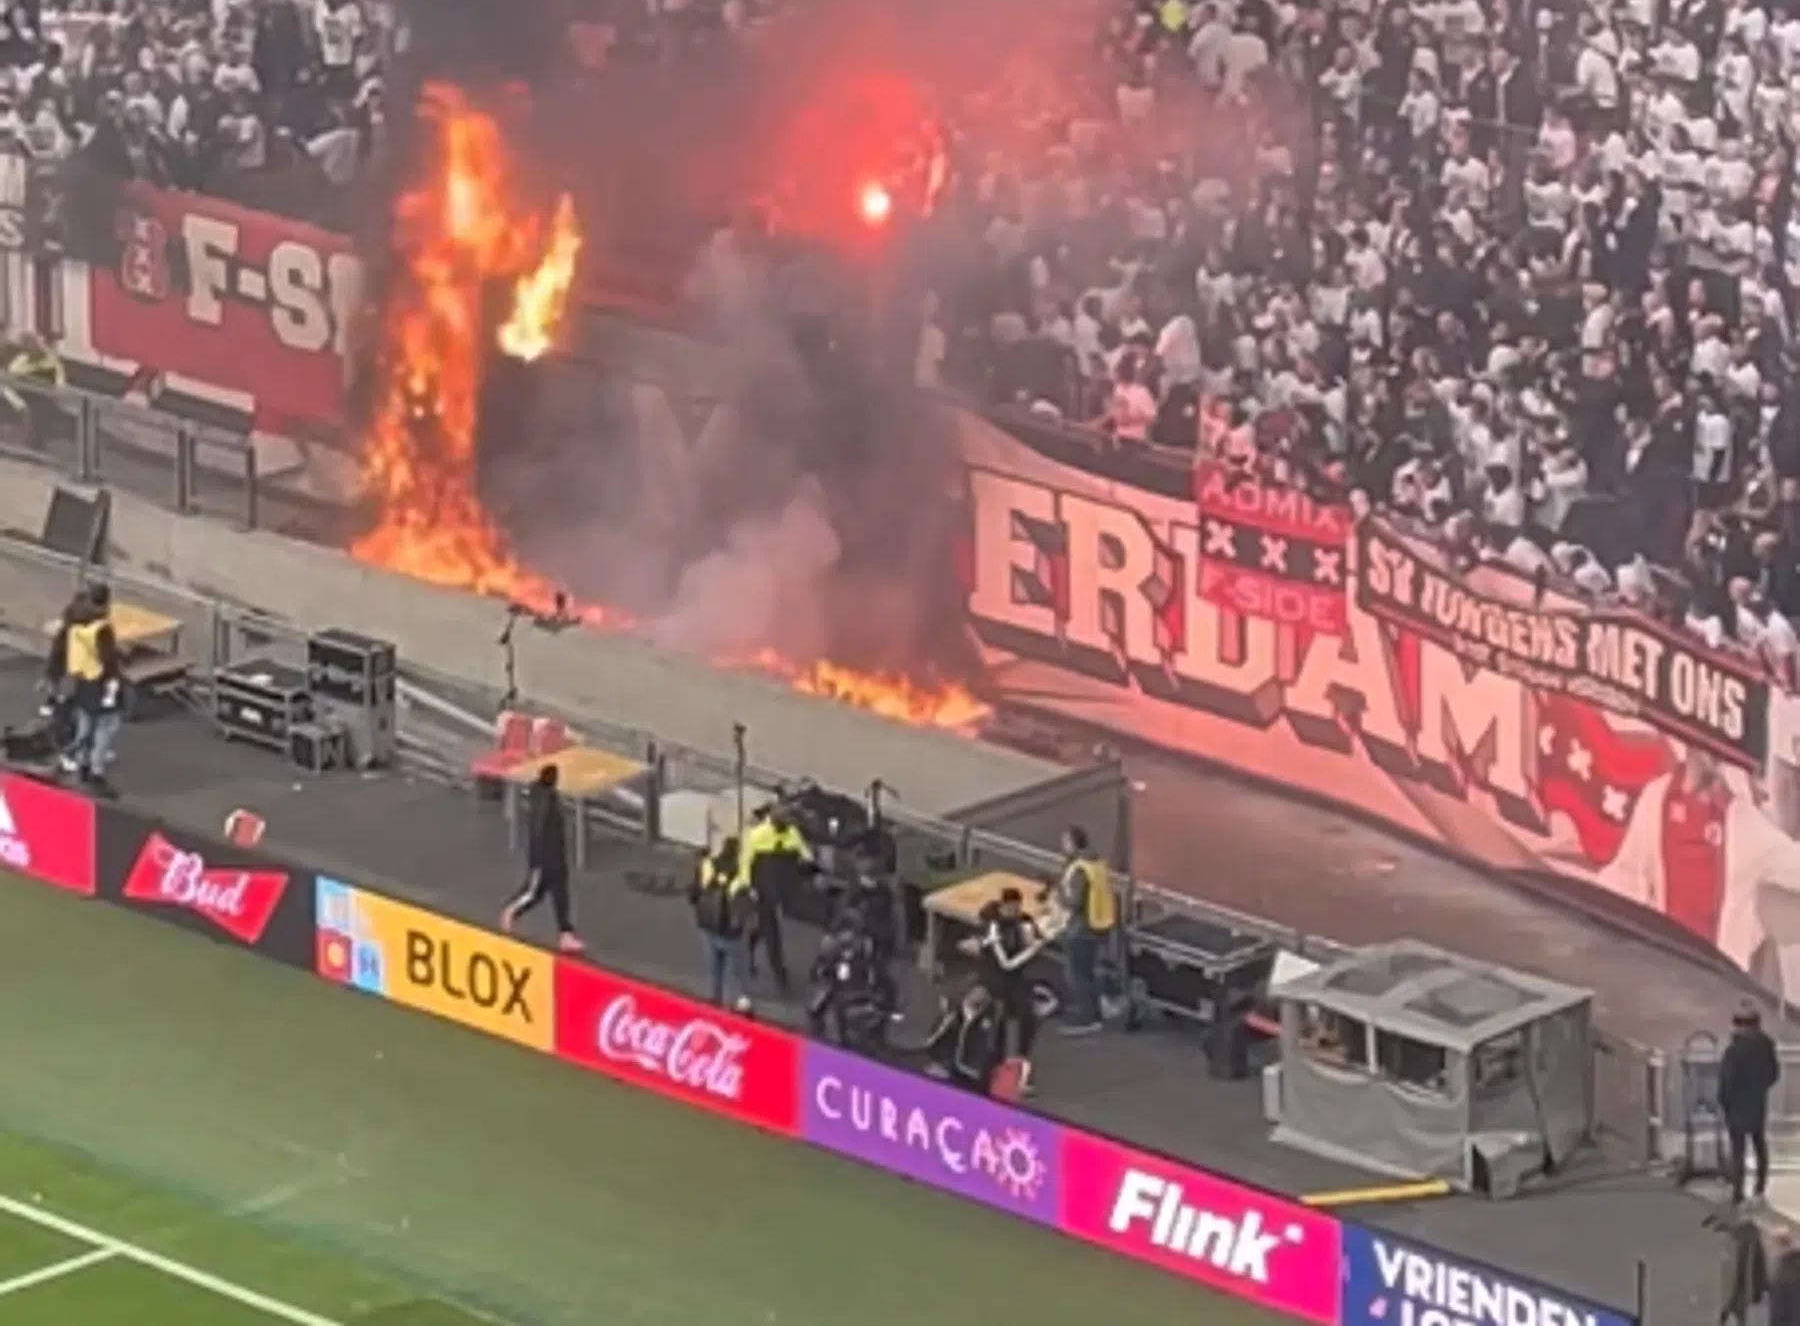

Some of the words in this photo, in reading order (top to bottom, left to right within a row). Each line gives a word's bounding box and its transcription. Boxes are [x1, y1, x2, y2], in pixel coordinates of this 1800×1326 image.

[1585, 622, 1664, 701] MET
[1668, 653, 1747, 741] ONS
[155, 845, 250, 917] Bud
[406, 928, 533, 1024] BLOX
[1109, 1168, 1280, 1284] Flink
